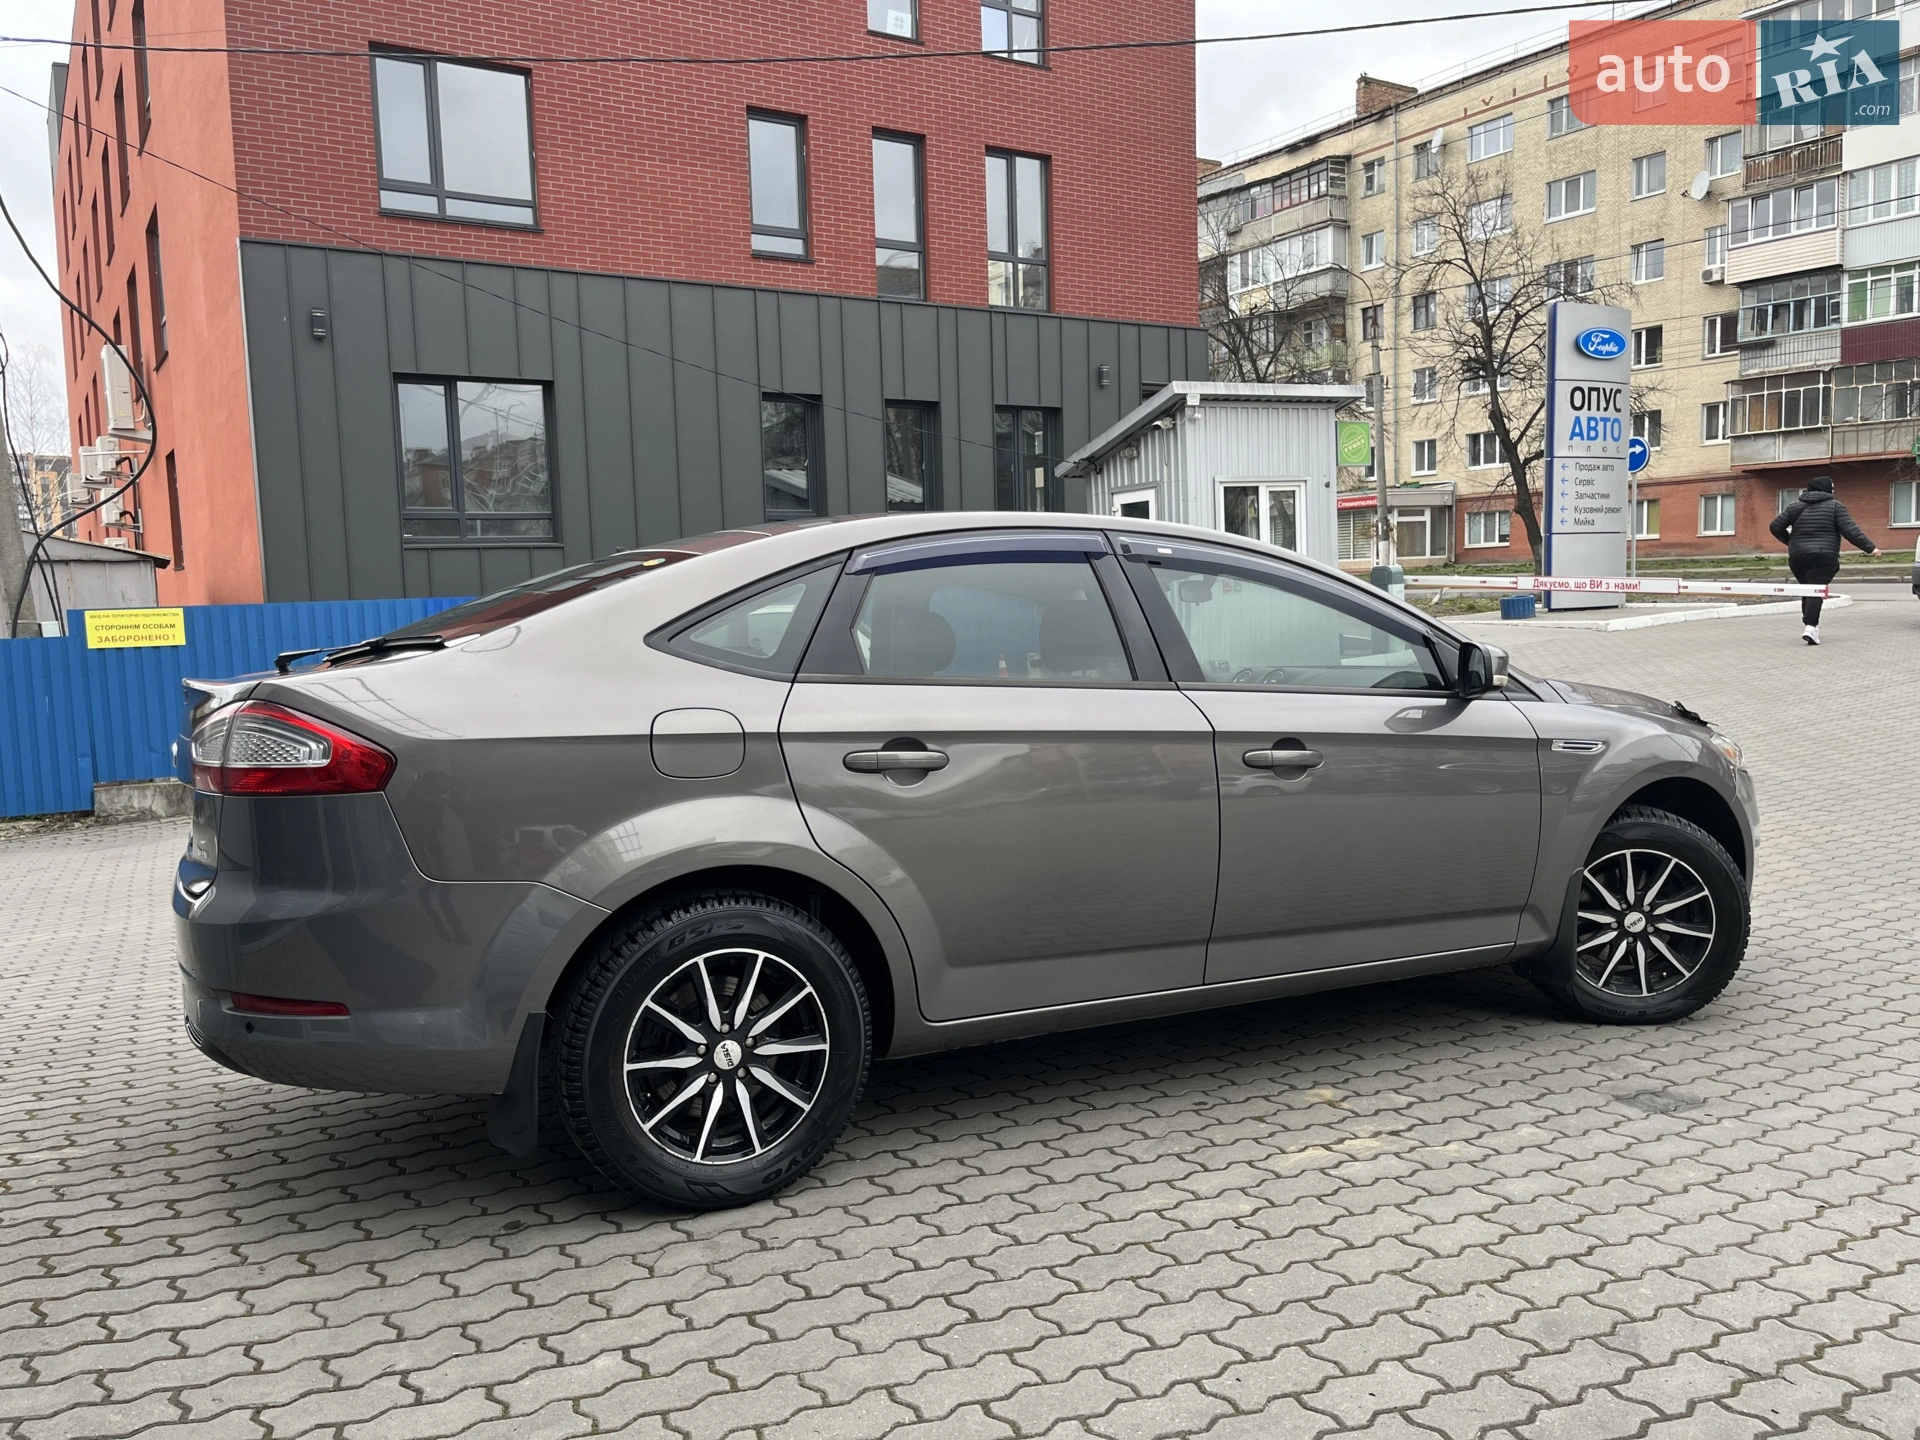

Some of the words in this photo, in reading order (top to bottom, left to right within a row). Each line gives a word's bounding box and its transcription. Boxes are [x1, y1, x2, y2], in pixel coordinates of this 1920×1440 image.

[1570, 386, 1622, 413] ОПУС
[1569, 416, 1622, 442] АВТО
[1575, 462, 1601, 472] Продаж
[1574, 477, 1595, 487] Сервіс
[1574, 491, 1610, 500] Запчастини
[1573, 505, 1603, 515] Кузовний
[1573, 517, 1595, 526] Мийка
[1532, 579, 1572, 590] Дякуємо,
[1574, 581, 1587, 590] що
[1590, 580, 1603, 589] ВИ
[1605, 582, 1610, 590] з
[1614, 581, 1641, 590] нами!
[97, 634, 170, 643] ЗАБОРОНЕНО
